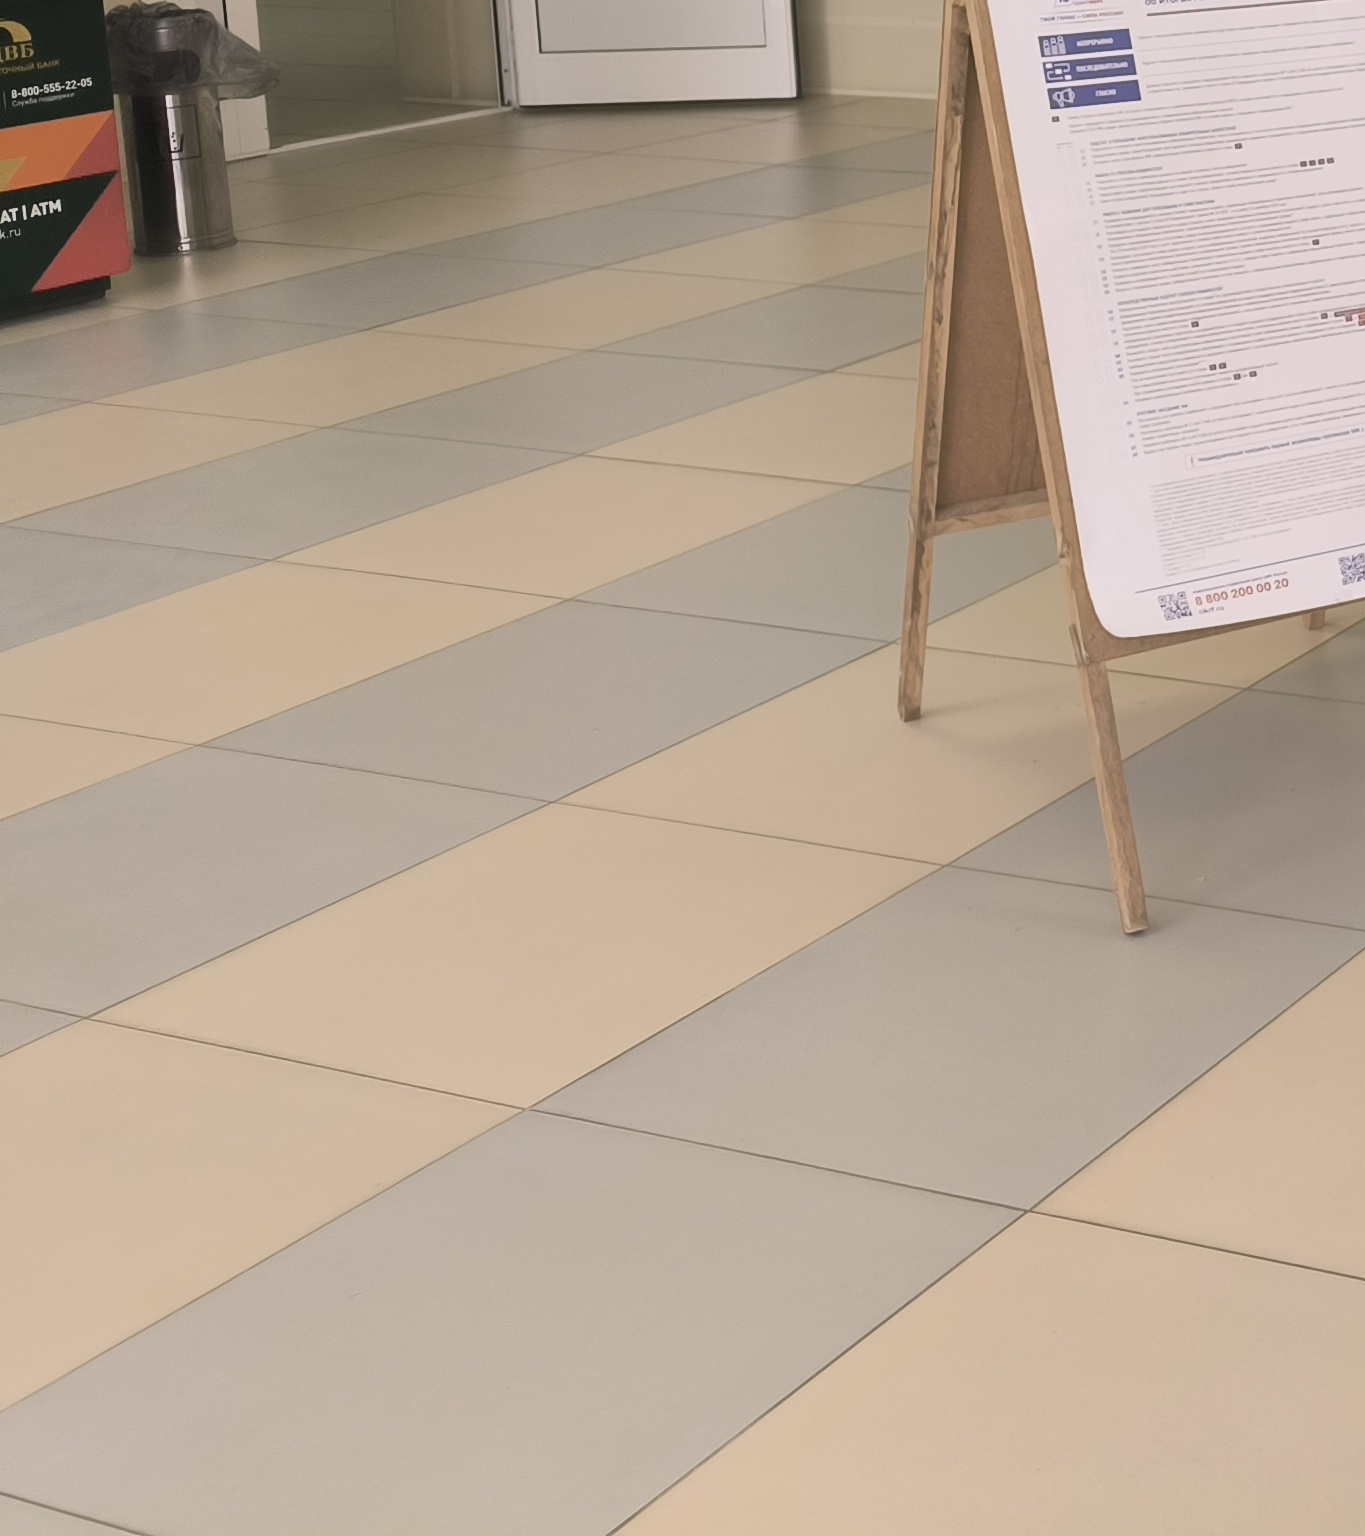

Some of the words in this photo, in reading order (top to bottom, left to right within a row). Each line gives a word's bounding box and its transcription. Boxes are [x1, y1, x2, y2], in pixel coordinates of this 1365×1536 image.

[0, 42, 35, 63] ВБ
[1205, 591, 1229, 604] 800
[1231, 585, 1254, 599] 200
[1256, 581, 1272, 593] 00
[1274, 577, 1289, 590] 20
